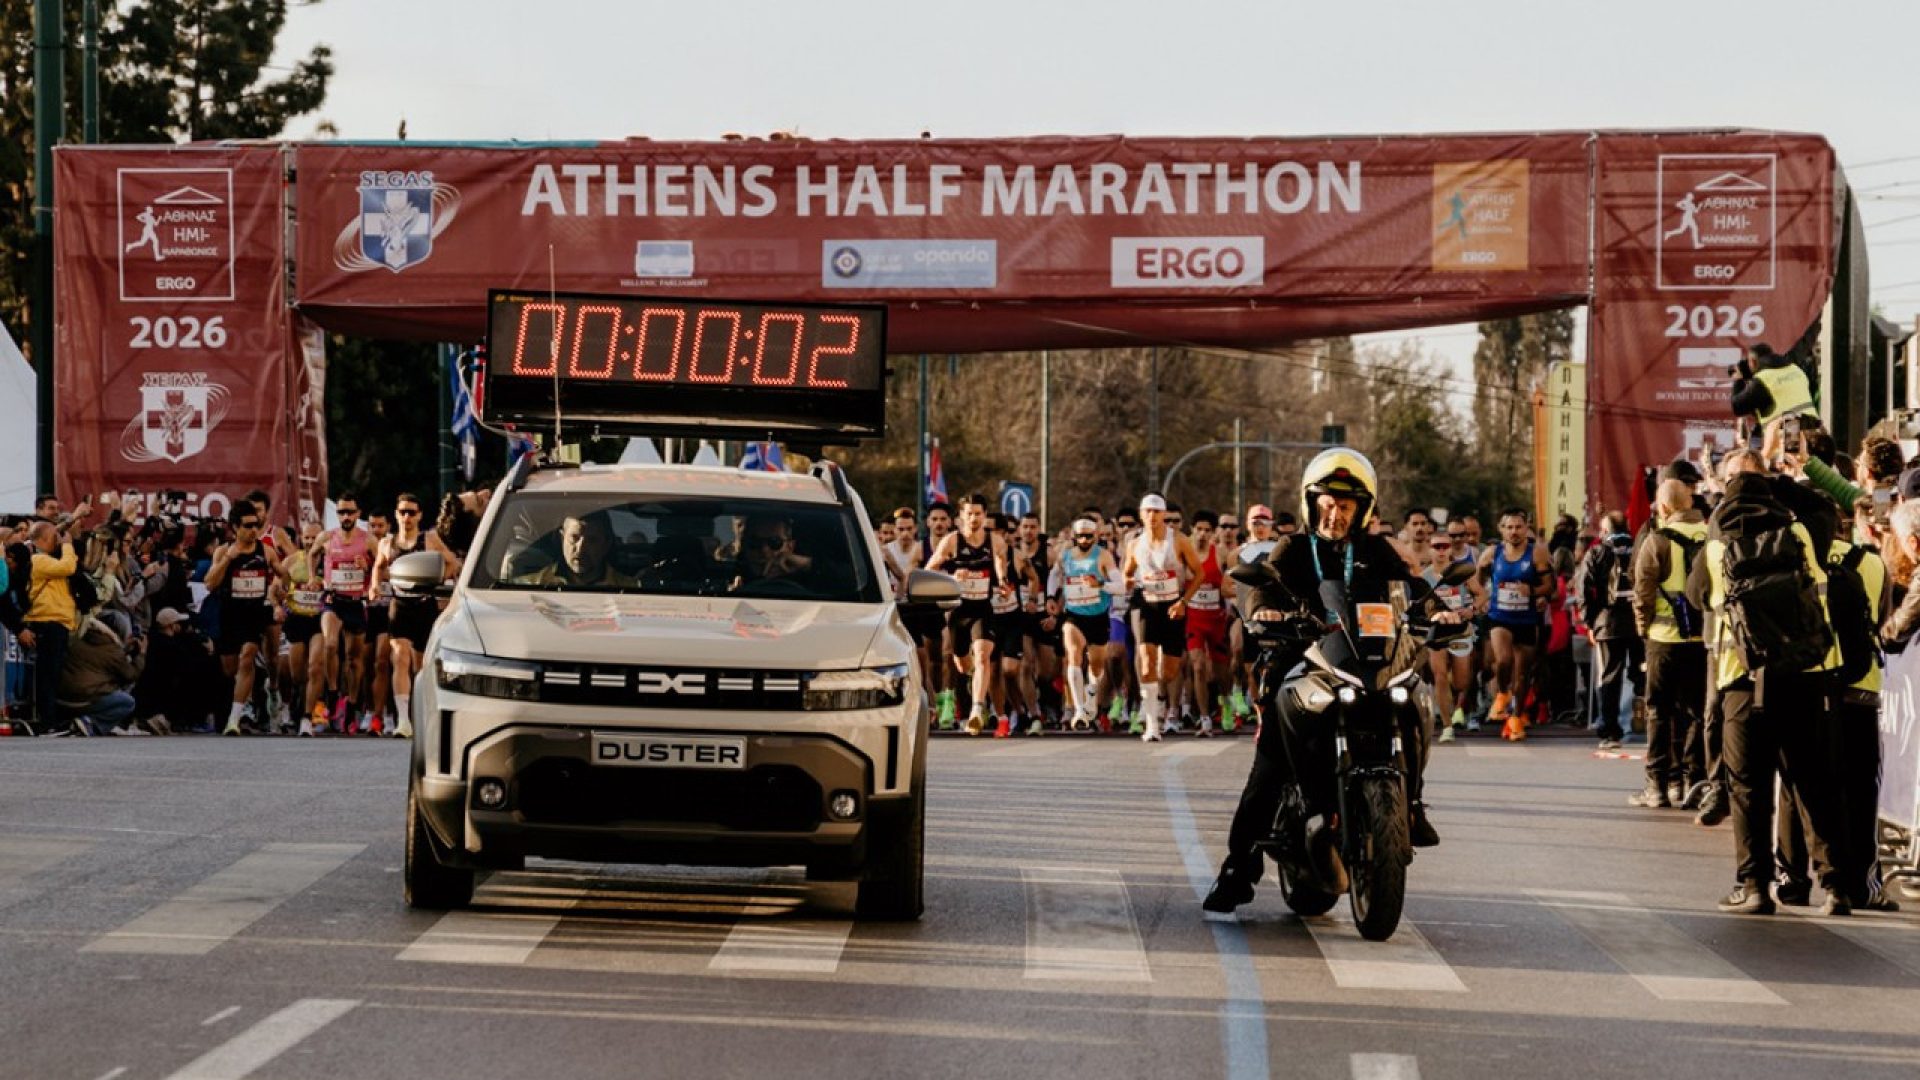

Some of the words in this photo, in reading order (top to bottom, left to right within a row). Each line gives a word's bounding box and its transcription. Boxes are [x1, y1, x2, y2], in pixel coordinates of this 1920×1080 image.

[361, 172, 433, 187] SEGAS
[521, 164, 777, 217] ATHENS
[797, 164, 963, 217] HALF
[980, 161, 1362, 217] MARATHON
[1136, 247, 1245, 280] ERGO
[1694, 265, 1735, 279] ERGO
[156, 277, 196, 290] ERGO
[129, 316, 227, 348] 2026
[1664, 305, 1765, 337] 2026
[513, 302, 862, 388] 00:00:02
[598, 742, 741, 763] DUSTER
